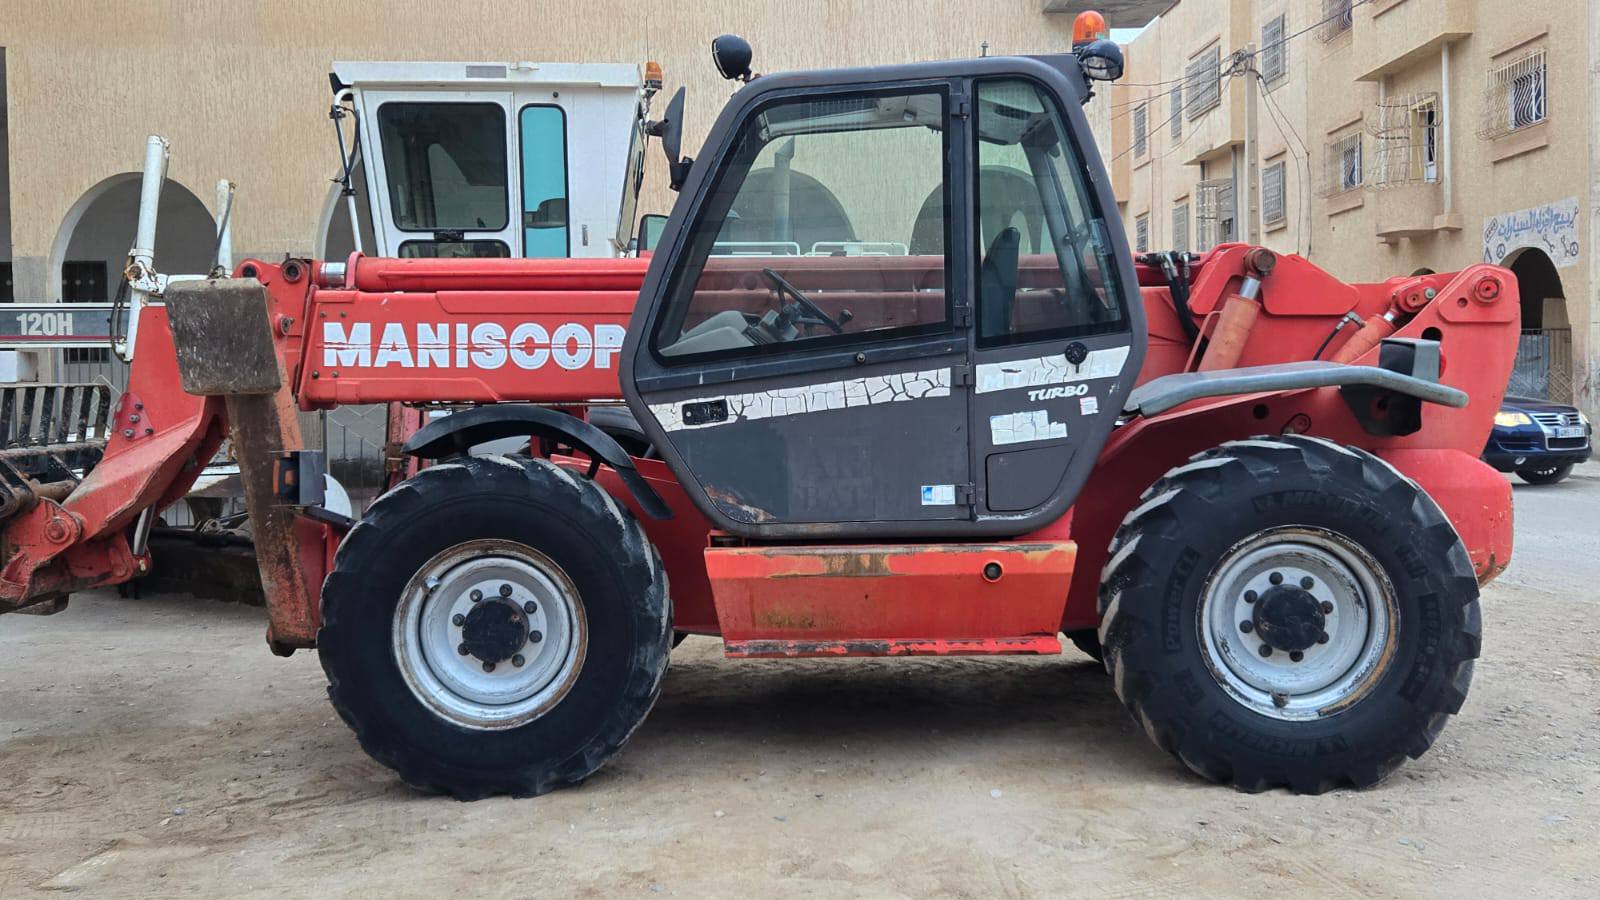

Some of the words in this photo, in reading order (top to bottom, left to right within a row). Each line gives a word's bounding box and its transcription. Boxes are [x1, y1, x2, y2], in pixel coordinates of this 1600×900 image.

[16, 312, 73, 336] 120H
[323, 322, 627, 370] MANISCOP
[1028, 383, 1089, 402] TURBO
